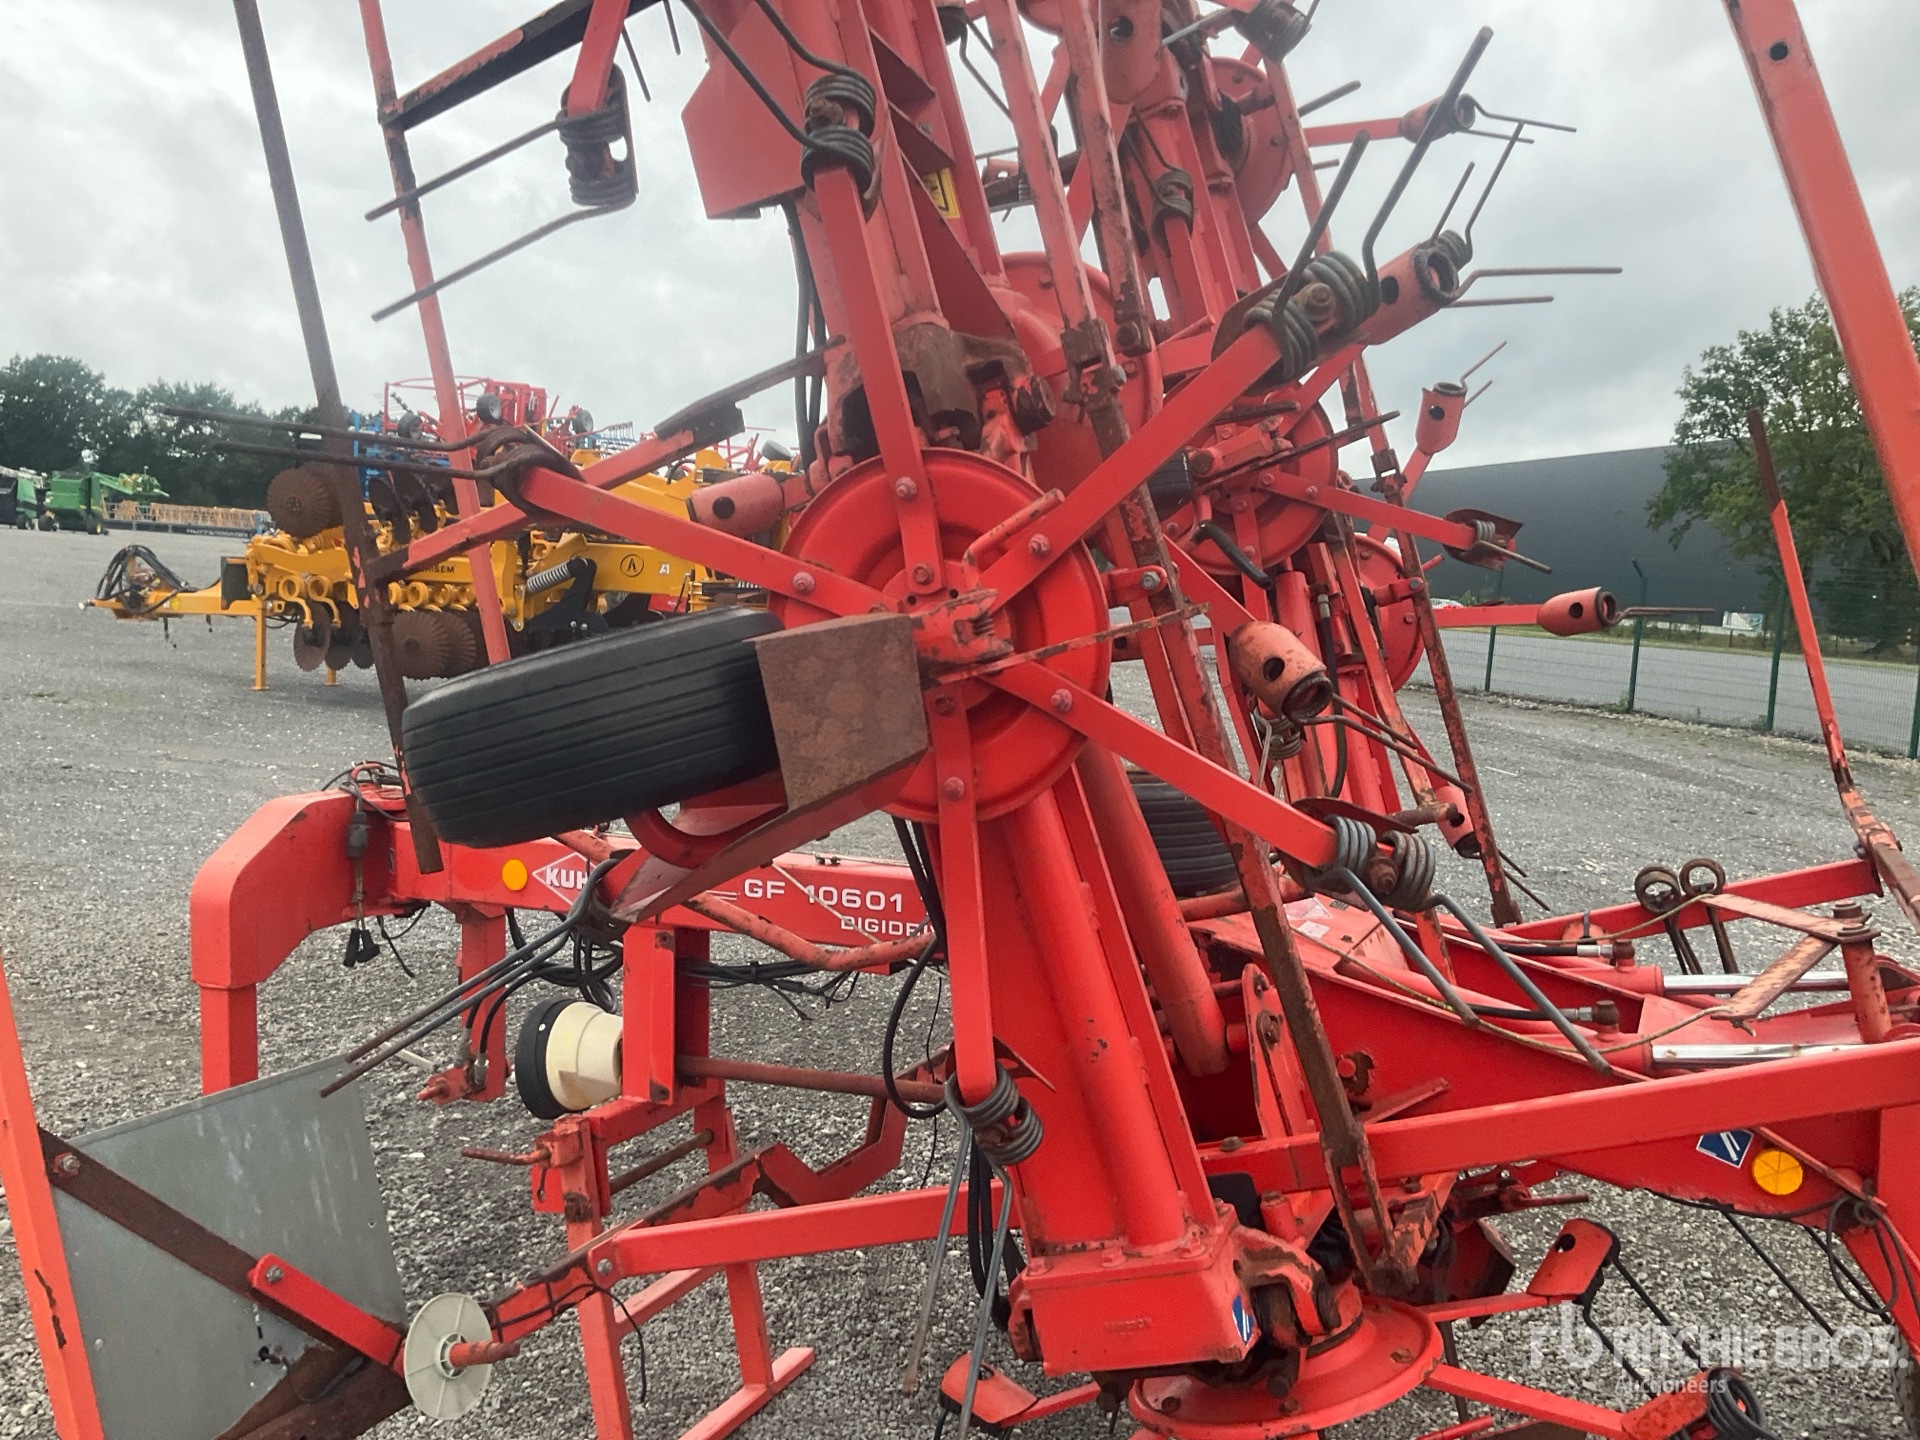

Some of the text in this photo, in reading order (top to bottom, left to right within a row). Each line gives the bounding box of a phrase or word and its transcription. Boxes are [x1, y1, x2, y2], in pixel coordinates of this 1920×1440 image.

[546, 867, 588, 890] KUH
[744, 878, 903, 913] GF 10601
